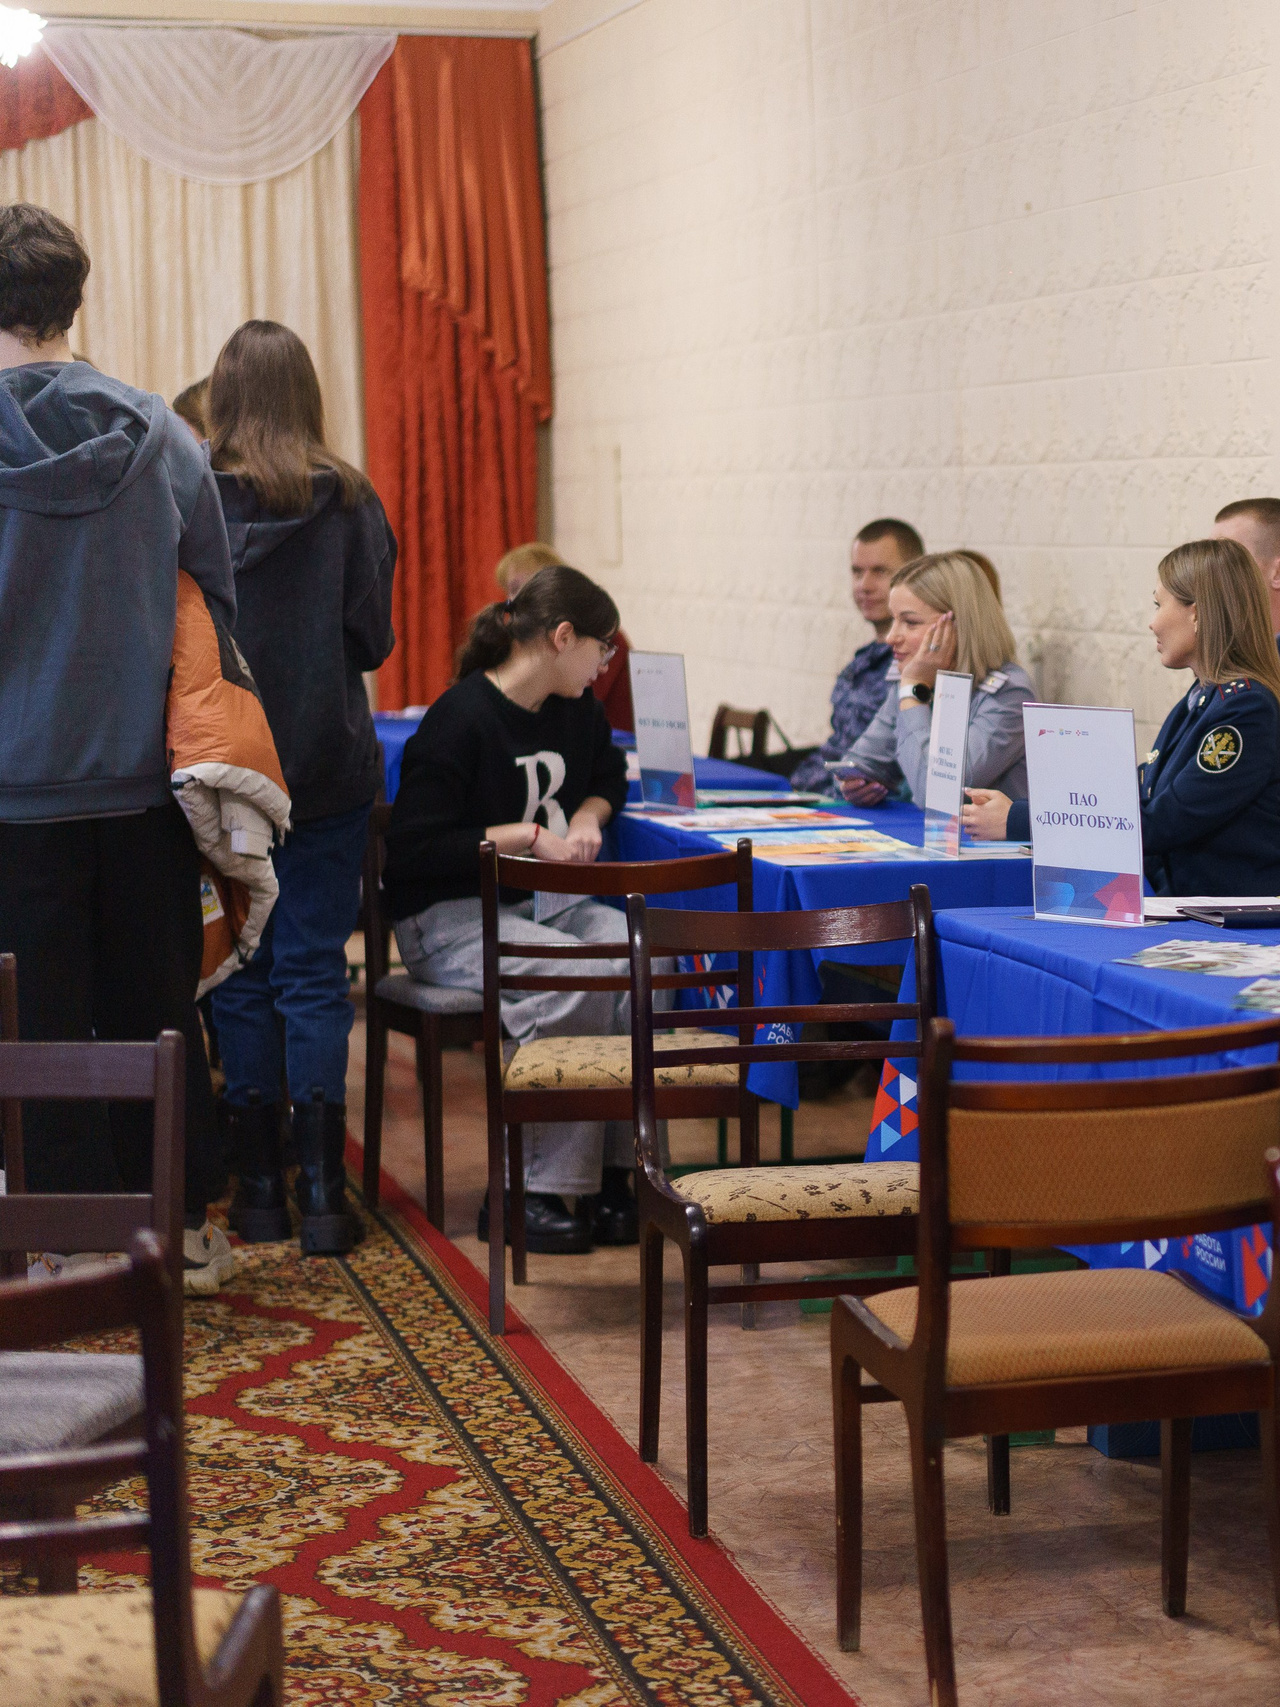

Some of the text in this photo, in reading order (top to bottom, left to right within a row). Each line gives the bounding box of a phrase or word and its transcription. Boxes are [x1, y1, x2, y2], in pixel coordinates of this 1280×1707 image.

[514, 750, 569, 839] R
[1069, 792, 1098, 807] ПАО
[1036, 811, 1135, 831] «ДОРОГОБУЖ»
[772, 1023, 793, 1040] РАБ
[1195, 1245, 1226, 1272] РОССИИ
